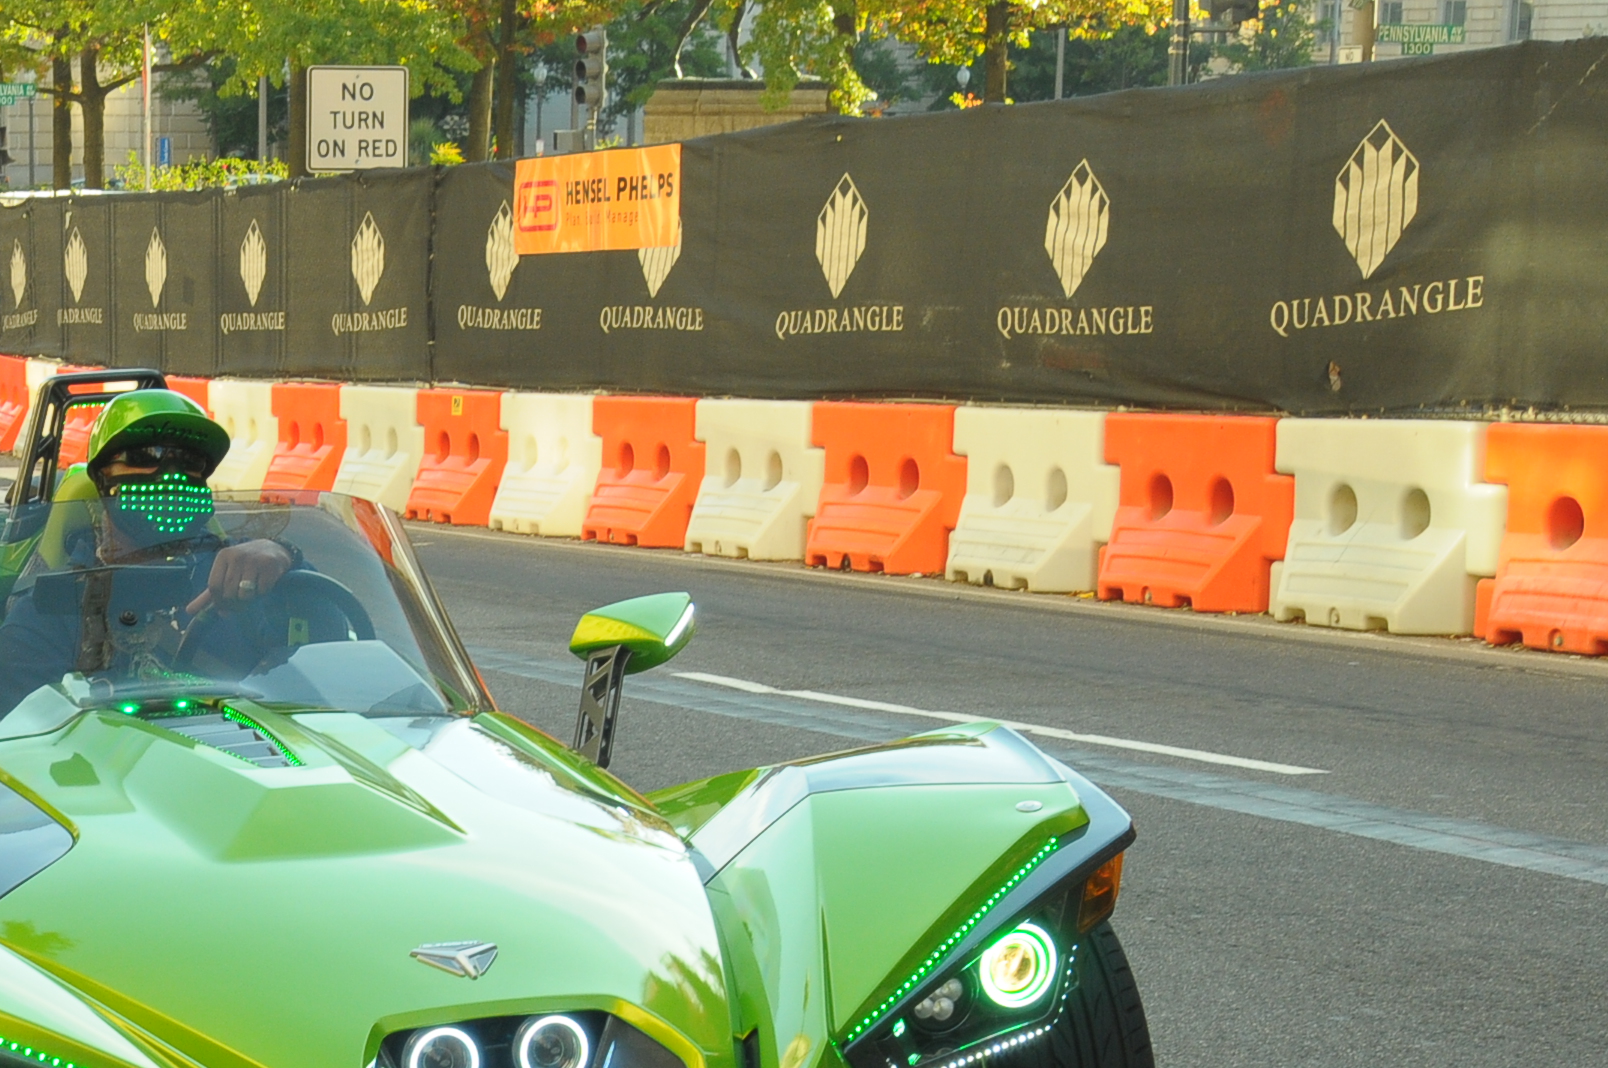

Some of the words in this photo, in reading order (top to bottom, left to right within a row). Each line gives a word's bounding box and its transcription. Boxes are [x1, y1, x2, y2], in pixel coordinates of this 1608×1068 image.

[1378, 25, 1448, 43] PENNSYLVANIA
[1345, 51, 1354, 61] NO
[1404, 43, 1431, 54] 1300
[341, 82, 374, 101] NO
[329, 110, 385, 130] TURN
[317, 139, 345, 158] ON
[358, 139, 398, 158] RED
[566, 178, 611, 206] HENSEL
[616, 172, 674, 202] PHELPS
[457, 304, 542, 330] QUADRANGLE
[1270, 275, 1484, 337] QUADRANGLE
[133, 312, 187, 332] QUADRANGLE
[220, 311, 285, 335] QUADRANGLE
[331, 307, 408, 336] QUADRANGLE
[599, 306, 704, 334] QUADRANGLE
[775, 306, 904, 340] QUADRANGLE
[997, 305, 1154, 340] QUADRANGLE
